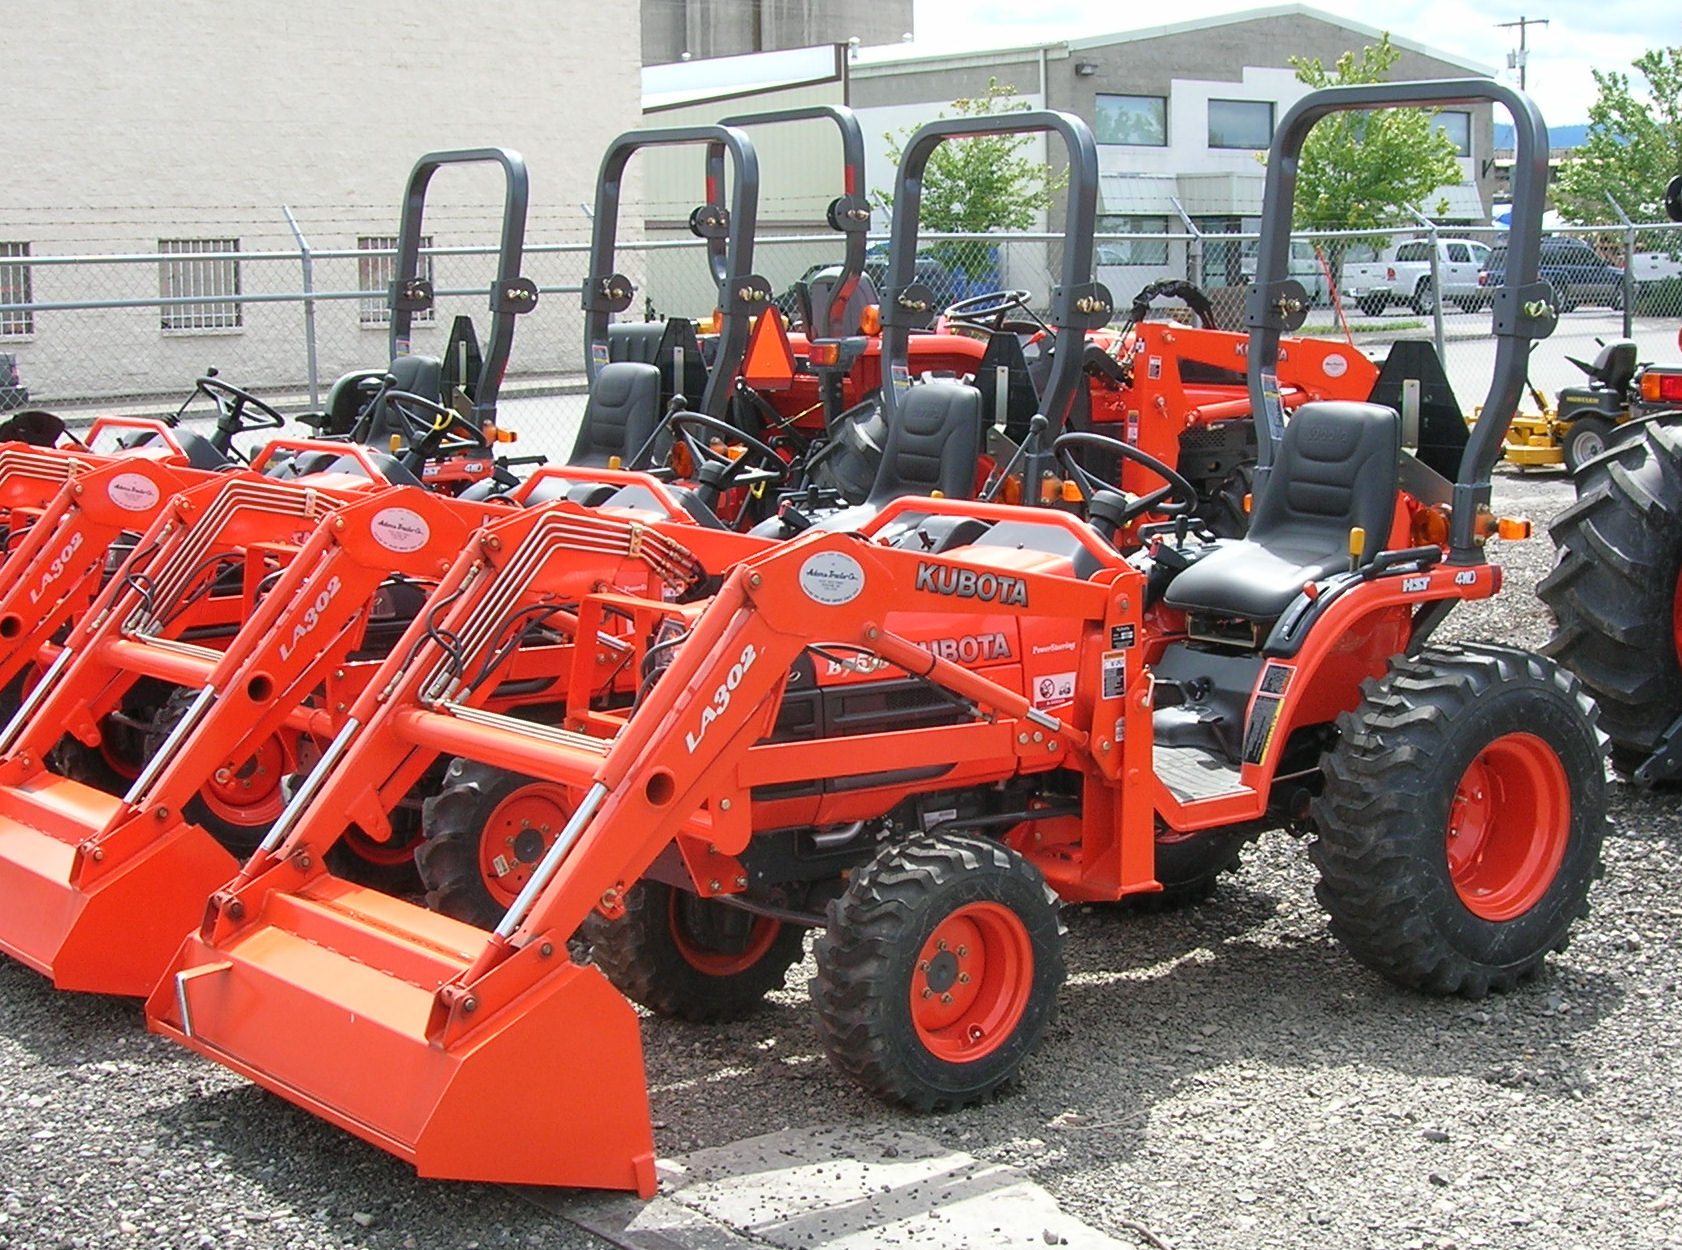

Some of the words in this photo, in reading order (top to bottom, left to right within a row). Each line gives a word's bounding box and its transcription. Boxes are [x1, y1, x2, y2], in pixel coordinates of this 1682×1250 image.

[30, 531, 84, 605] LA302
[916, 560, 1028, 608] KUBOTA
[279, 575, 342, 662] LA302
[685, 643, 757, 754] LA302
